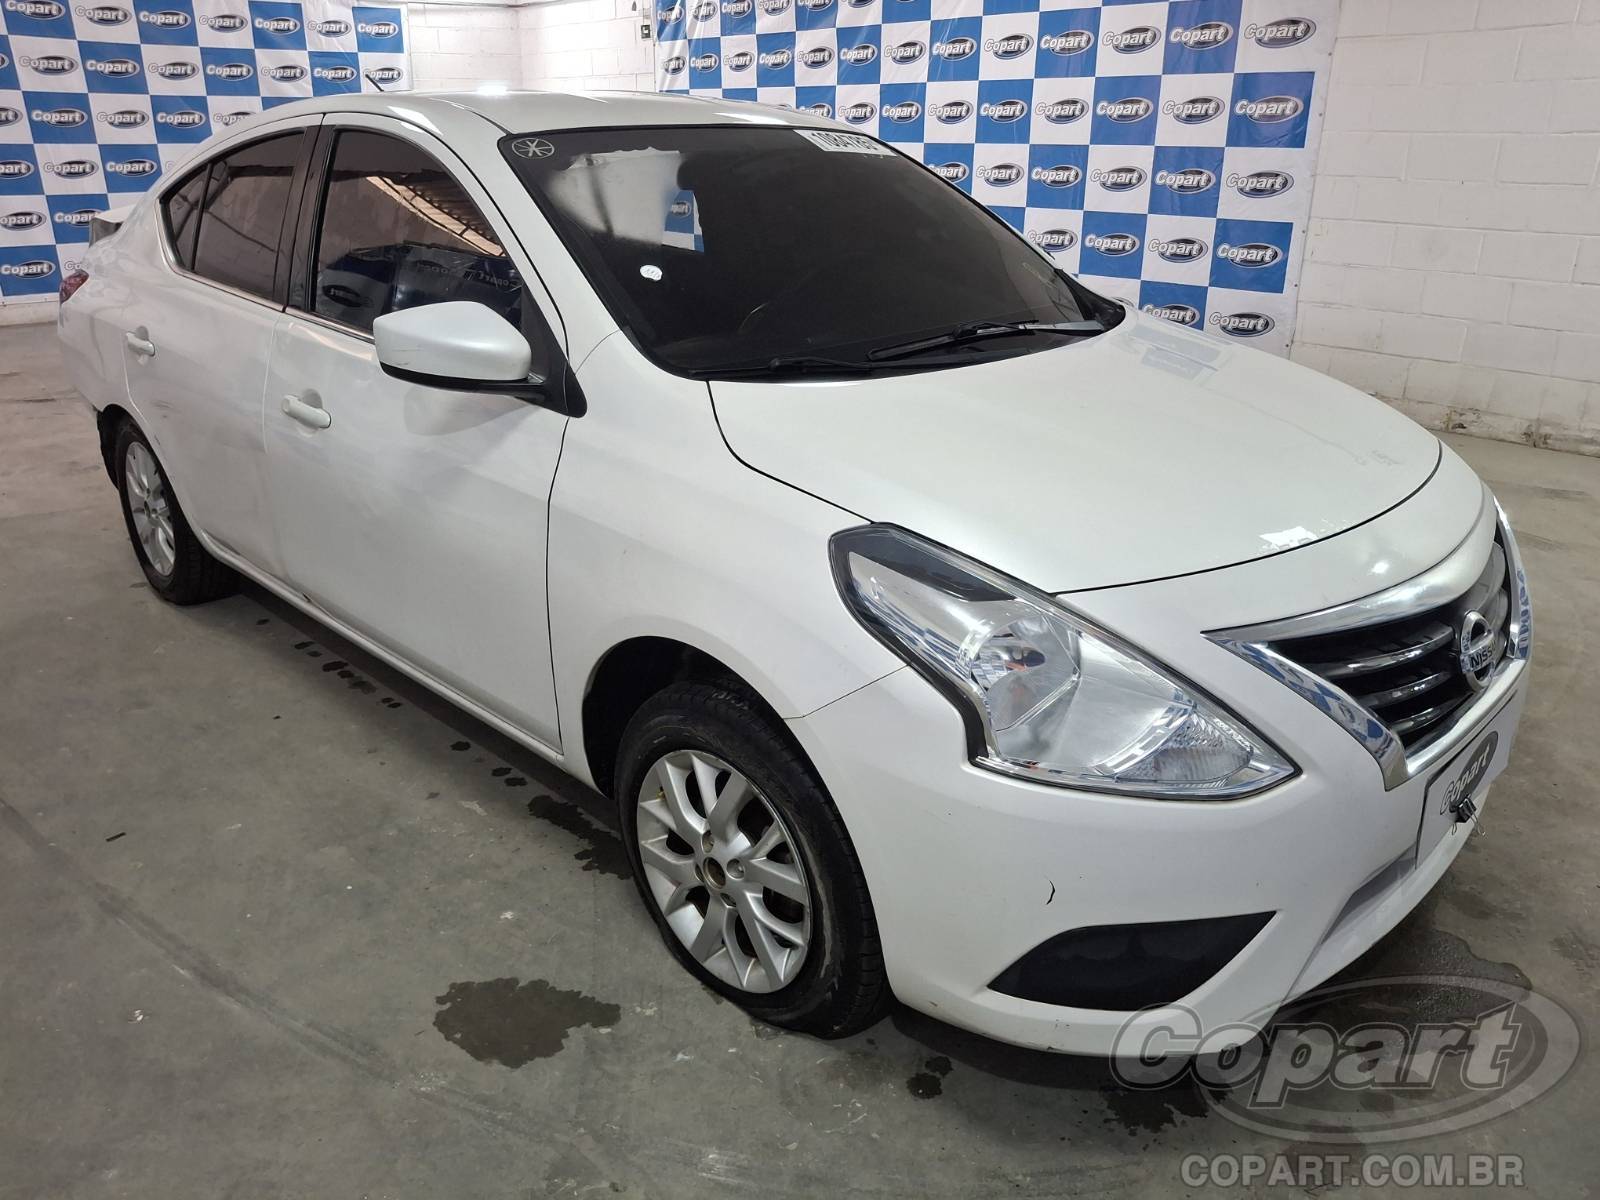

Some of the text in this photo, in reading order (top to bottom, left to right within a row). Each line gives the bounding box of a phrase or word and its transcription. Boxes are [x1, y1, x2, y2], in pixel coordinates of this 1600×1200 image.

[5, 0, 59, 15] Copart
[722, 1, 750, 14] Copart
[759, 0, 788, 11] Copart
[76, 6, 125, 23] Copart
[139, 11, 186, 26] Copart
[200, 14, 243, 29] Copart
[254, 18, 296, 32] Copart
[308, 20, 346, 34] Copart
[357, 23, 395, 36] Copart
[1244, 22, 1306, 42] Copart
[1040, 33, 1087, 50] Copart
[1102, 30, 1152, 48] Copart
[1169, 26, 1225, 44] Copart
[932, 40, 970, 57] Copart
[984, 36, 1027, 54] Copart
[724, 54, 751, 68] Copart
[759, 52, 788, 66] Copart
[797, 50, 829, 64] Copart
[840, 48, 873, 61] Copart
[884, 45, 920, 62] Copart
[19, 56, 71, 73] Copart
[86, 60, 134, 75] Copart
[148, 63, 193, 77] Copart
[690, 56, 715, 69] Copart
[206, 64, 249, 78] Copart
[261, 66, 302, 80] Copart
[313, 67, 352, 81] Copart
[838, 105, 873, 119] Copart
[881, 103, 918, 119] Copart
[928, 102, 968, 119] Copart
[980, 101, 1022, 119] Copart
[1035, 101, 1082, 119] Copart
[1096, 100, 1147, 118] Copart
[1162, 99, 1217, 118] Copart
[1235, 99, 1294, 118] Copart
[31, 110, 83, 125] Copart
[97, 111, 143, 126] Copart
[157, 112, 201, 125] Copart
[0, 163, 28, 175] part
[44, 161, 92, 176] Copart
[106, 161, 152, 175] Copart
[976, 166, 1018, 182] Copart
[1031, 167, 1077, 184] Copart
[1091, 168, 1139, 187] Copart
[1156, 170, 1209, 188] Copart
[1226, 173, 1283, 192] Copart
[0, 213, 38, 226] opart
[1027, 230, 1071, 246] Copart
[1085, 234, 1132, 252] Copart
[1148, 239, 1201, 256] Copart
[1216, 244, 1274, 262] Copart
[1, 261, 50, 276] Copart
[1209, 312, 1266, 331] Copart
[1440, 743, 1490, 815] Copart
